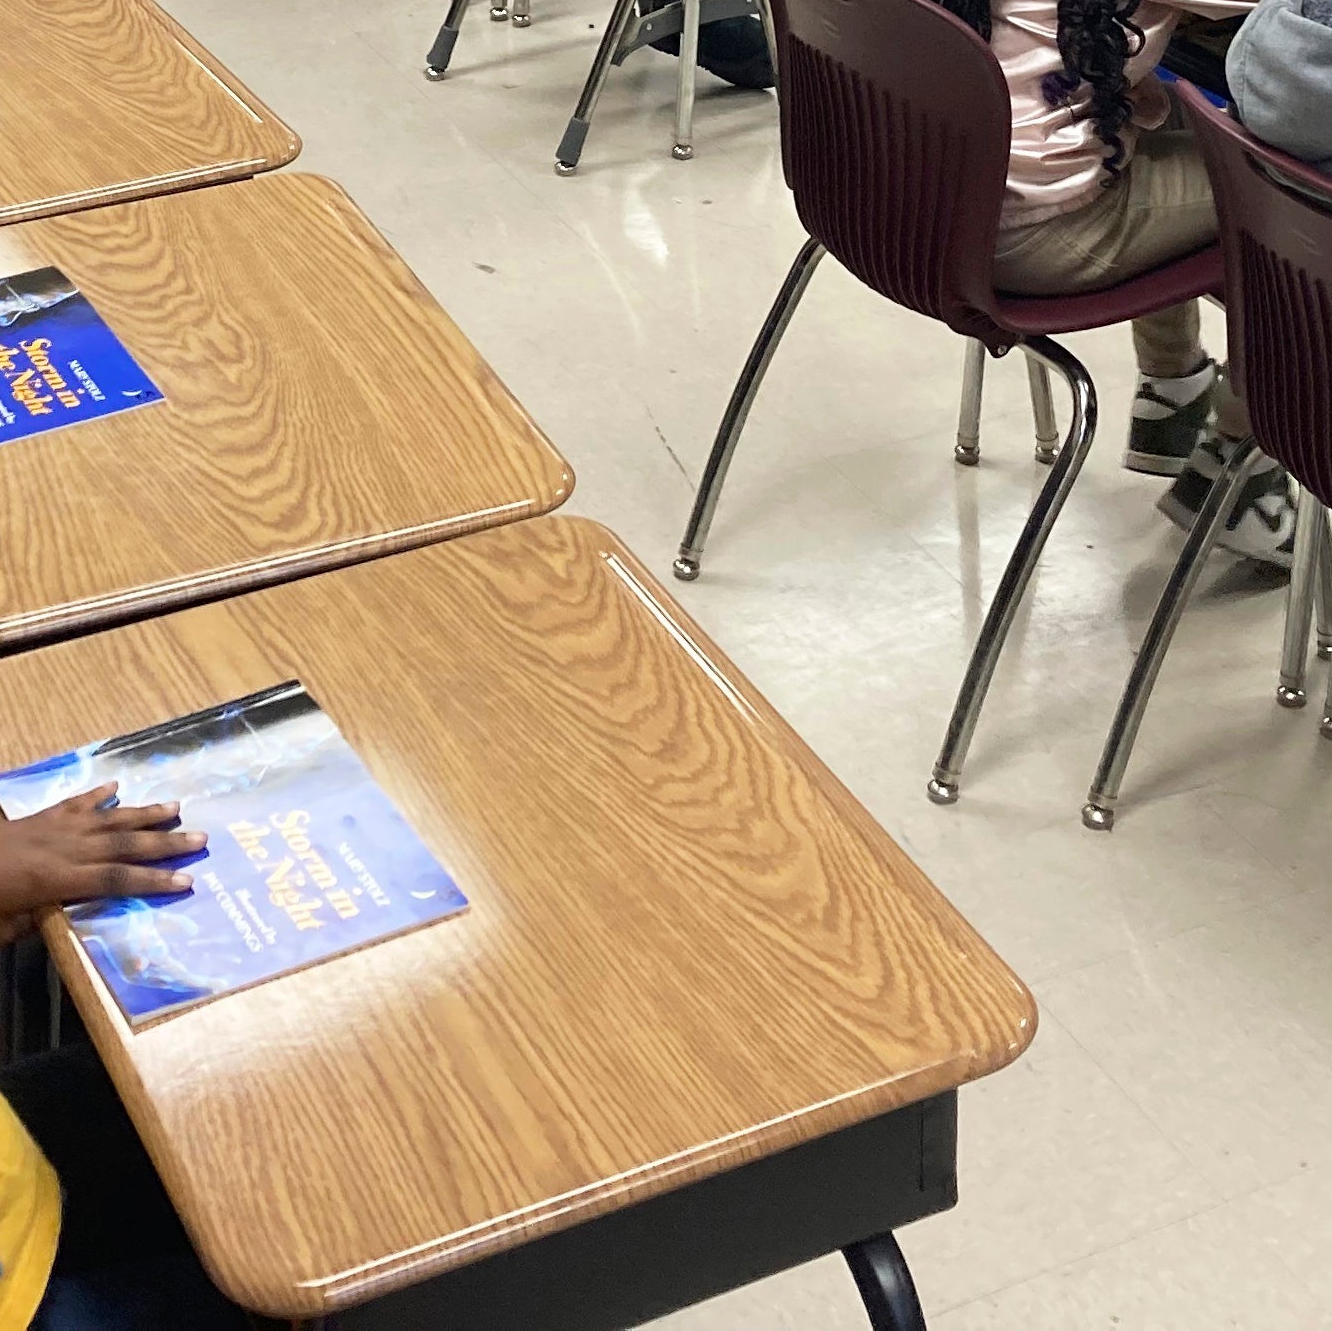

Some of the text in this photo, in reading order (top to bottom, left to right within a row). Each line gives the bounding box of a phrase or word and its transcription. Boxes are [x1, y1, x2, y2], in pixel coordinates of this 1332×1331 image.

[4, 368, 54, 417] Night
[19, 337, 68, 391] Storm
[226, 819, 271, 862] the
[254, 856, 327, 932] Night
[269, 809, 364, 920] Storm in
